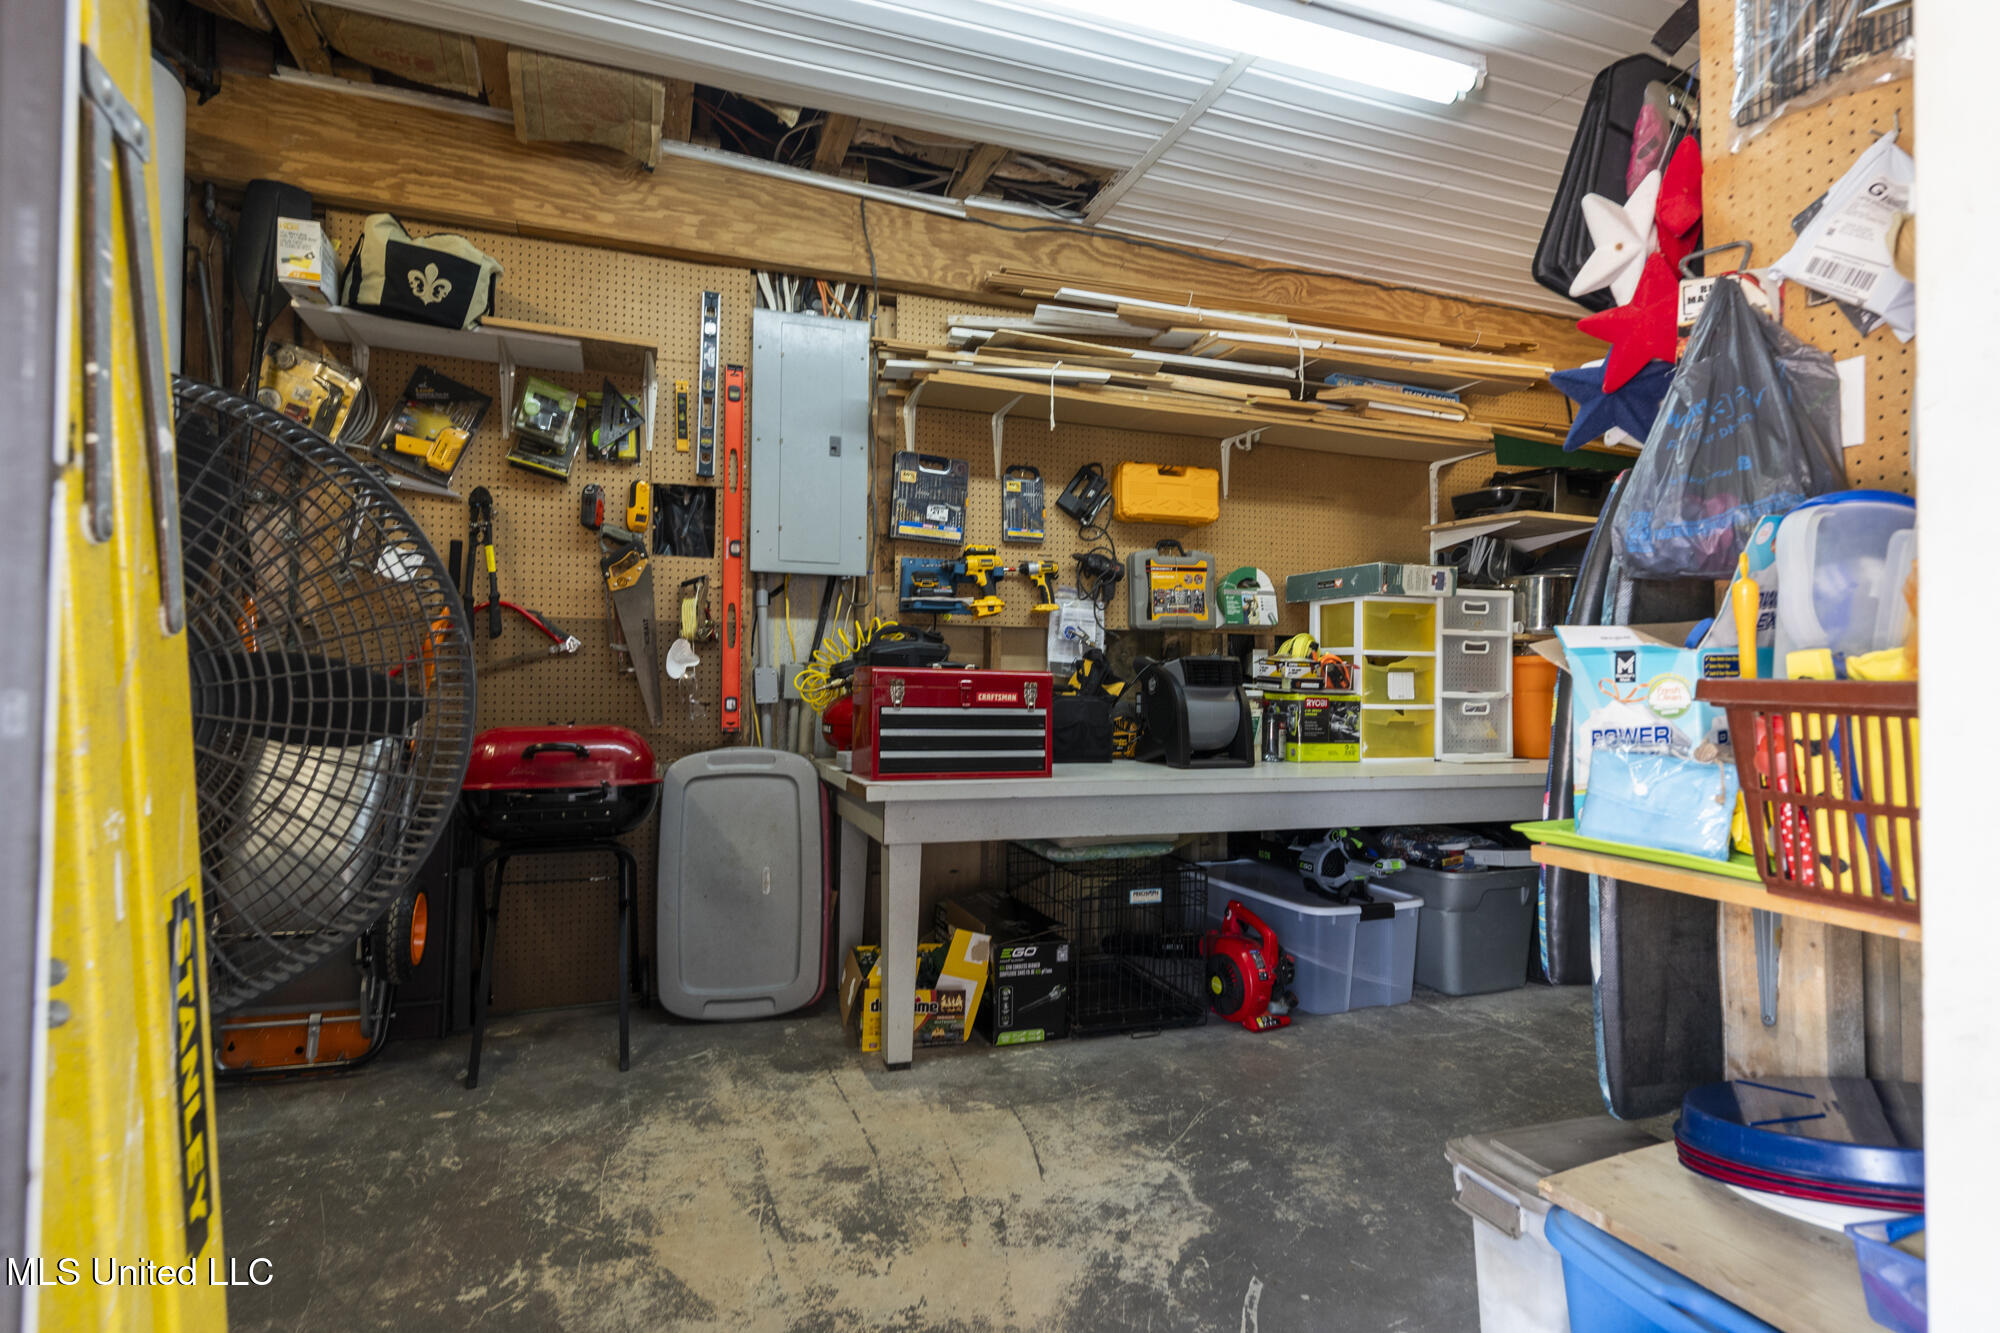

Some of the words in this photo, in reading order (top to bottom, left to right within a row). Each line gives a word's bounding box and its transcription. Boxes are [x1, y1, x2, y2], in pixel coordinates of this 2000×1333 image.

[977, 692, 1018, 702] CRAFTSMAN
[1305, 698, 1328, 708] RYOBI
[1591, 726, 1672, 747] POWER
[1299, 861, 1313, 871] EGO
[1000, 946, 1037, 959] EGO
[175, 916, 207, 1223] STANLEY
